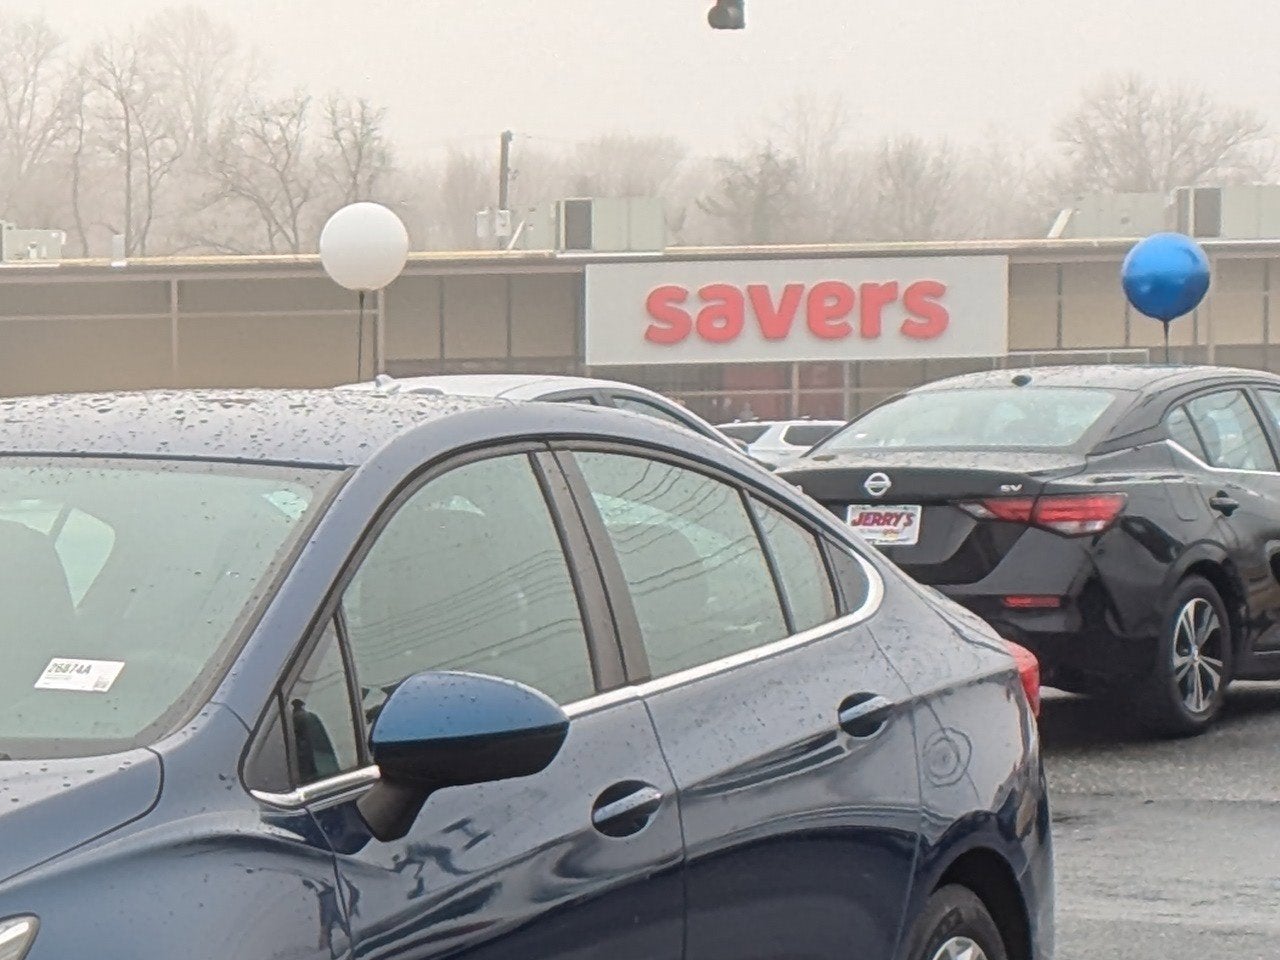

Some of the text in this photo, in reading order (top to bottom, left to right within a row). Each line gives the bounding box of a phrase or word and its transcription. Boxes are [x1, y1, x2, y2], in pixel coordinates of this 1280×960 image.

[643, 279, 950, 345] savers
[999, 483, 1023, 492] SV
[851, 511, 917, 527] JERRY'S
